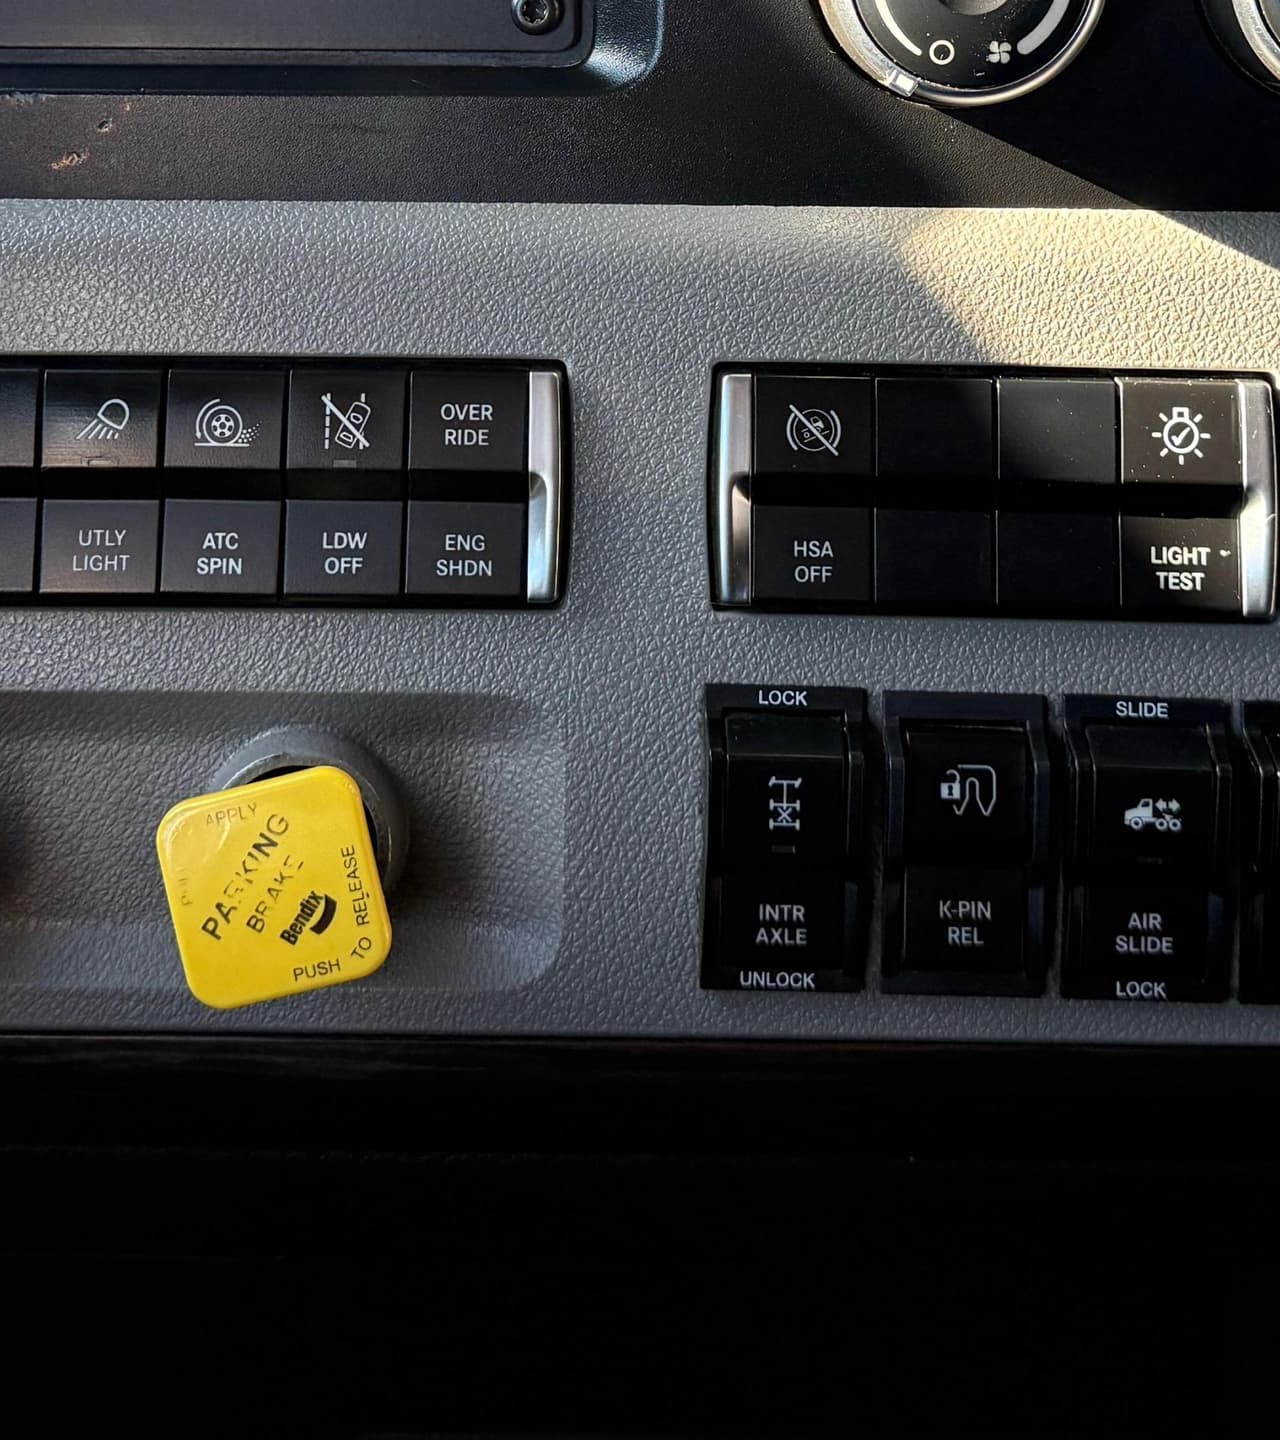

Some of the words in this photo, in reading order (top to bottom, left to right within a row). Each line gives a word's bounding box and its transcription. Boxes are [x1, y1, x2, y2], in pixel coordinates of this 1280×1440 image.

[439, 403, 494, 422] OVER
[444, 428, 490, 447] RIDE
[77, 529, 127, 547] UTLY
[201, 531, 239, 550] ATC
[321, 531, 368, 550] LDW
[444, 533, 486, 552] ENG
[792, 540, 835, 559] HSA
[1149, 545, 1211, 567] LIGHT
[72, 554, 130, 572] LIGHT
[196, 557, 243, 576] SPIN
[324, 556, 364, 575] OFF
[435, 558, 493, 577] SHDN
[794, 565, 833, 584] OFF
[1155, 571, 1206, 592] TEST
[757, 689, 808, 706] LOCK
[1115, 701, 1170, 719] SLIDE
[205, 802, 258, 827] APPLY
[340, 844, 371, 926] RELEASE
[278, 889, 325, 946] Bendix
[758, 904, 805, 922] INTR
[938, 900, 992, 920] K-PIN
[1127, 913, 1162, 931] AIR
[755, 928, 807, 945] AXLE
[947, 927, 984, 946] REL
[1115, 936, 1174, 954] SLIDE
[350, 936, 372, 960] TO
[292, 958, 341, 982] PUSH
[739, 971, 815, 989] UNLOCK
[1115, 981, 1167, 999] LOCK
